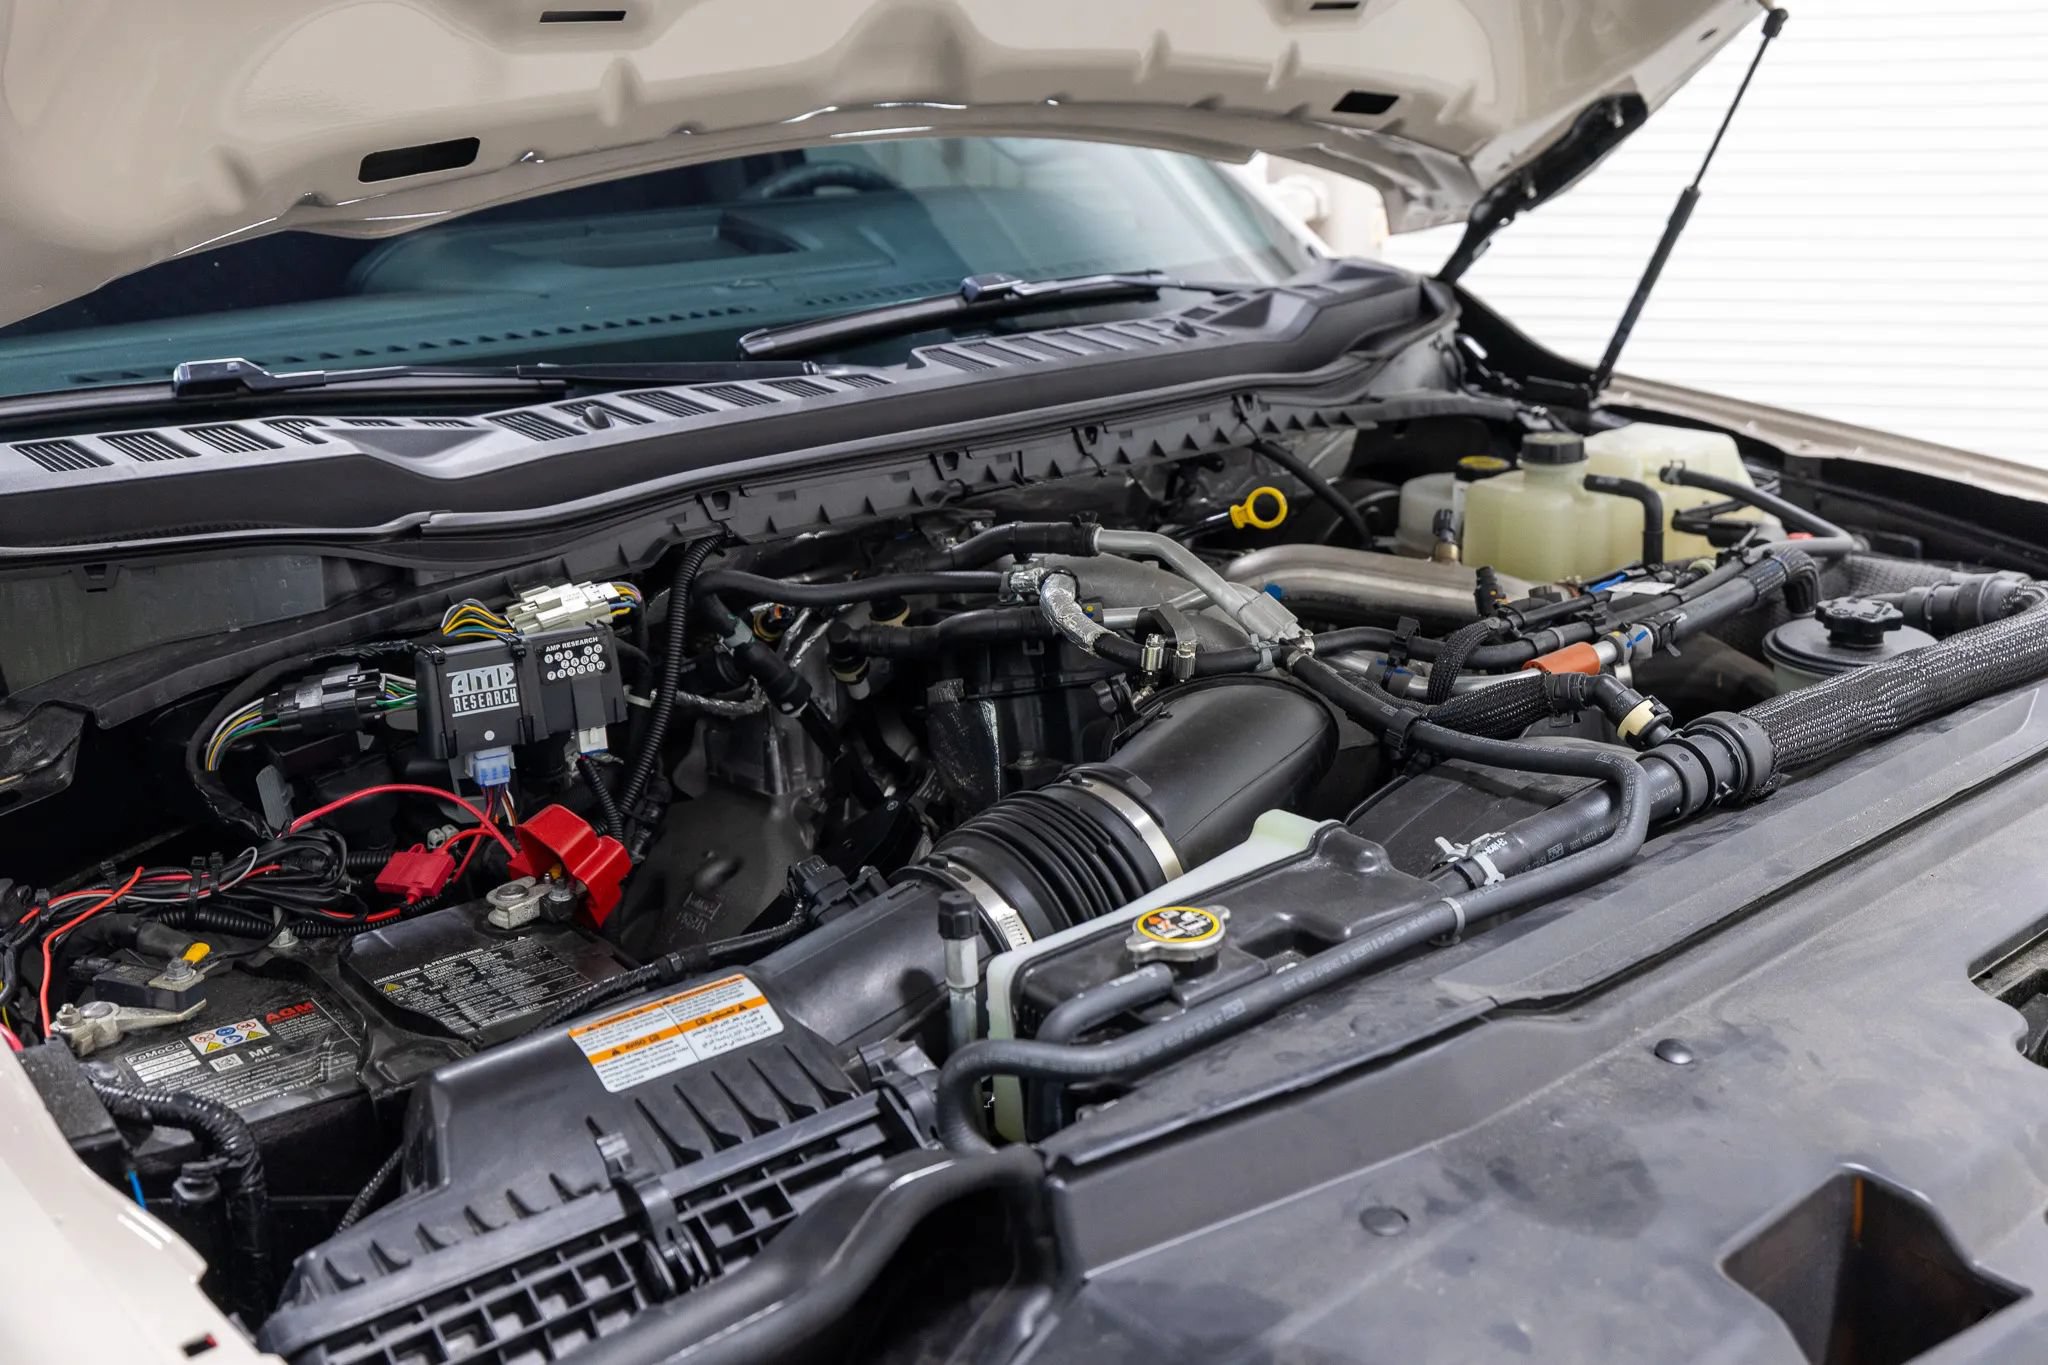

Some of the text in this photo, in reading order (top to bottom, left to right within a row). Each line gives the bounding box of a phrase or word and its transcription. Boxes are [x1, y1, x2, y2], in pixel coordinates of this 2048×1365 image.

[546, 636, 598, 652] AMP RESEARCH
[448, 664, 515, 697] AMP
[453, 688, 517, 712] RESEARCH
[374, 967, 420, 985] ANGER/POISON
[266, 1002, 314, 1023] AGM
[129, 1043, 183, 1063] FoMoCo
[248, 1045, 273, 1058] MF
